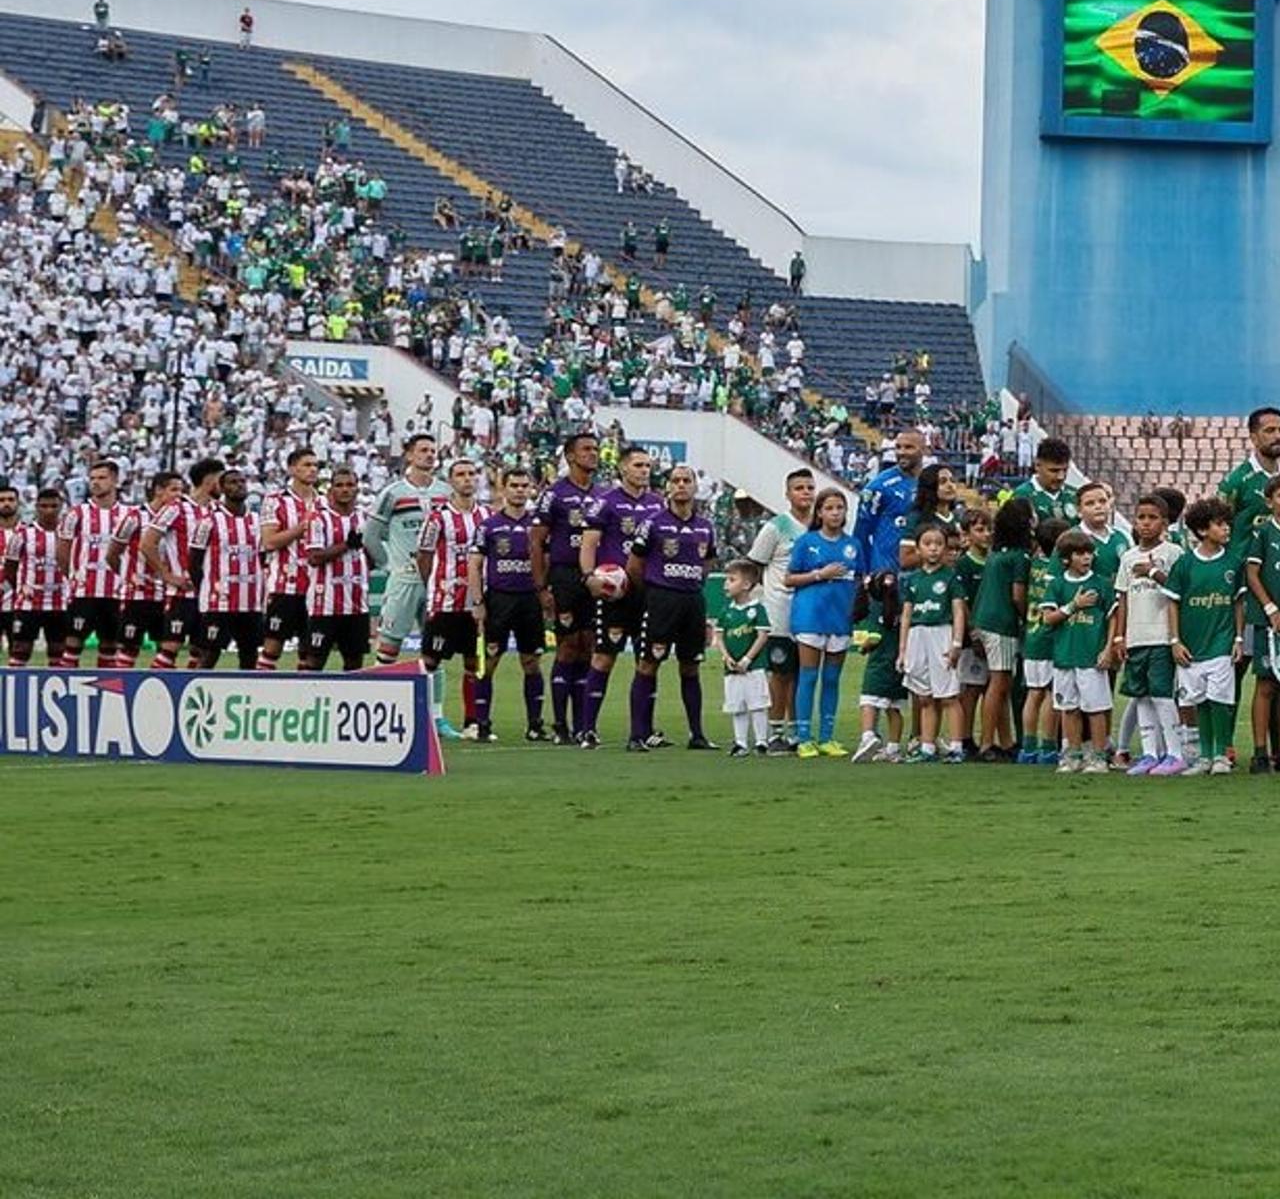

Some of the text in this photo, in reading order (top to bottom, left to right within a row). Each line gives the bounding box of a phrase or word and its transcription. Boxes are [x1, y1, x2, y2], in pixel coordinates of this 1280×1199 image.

[4, 675, 175, 757] LISTÃO
[223, 694, 408, 745] Sicredi 2024
